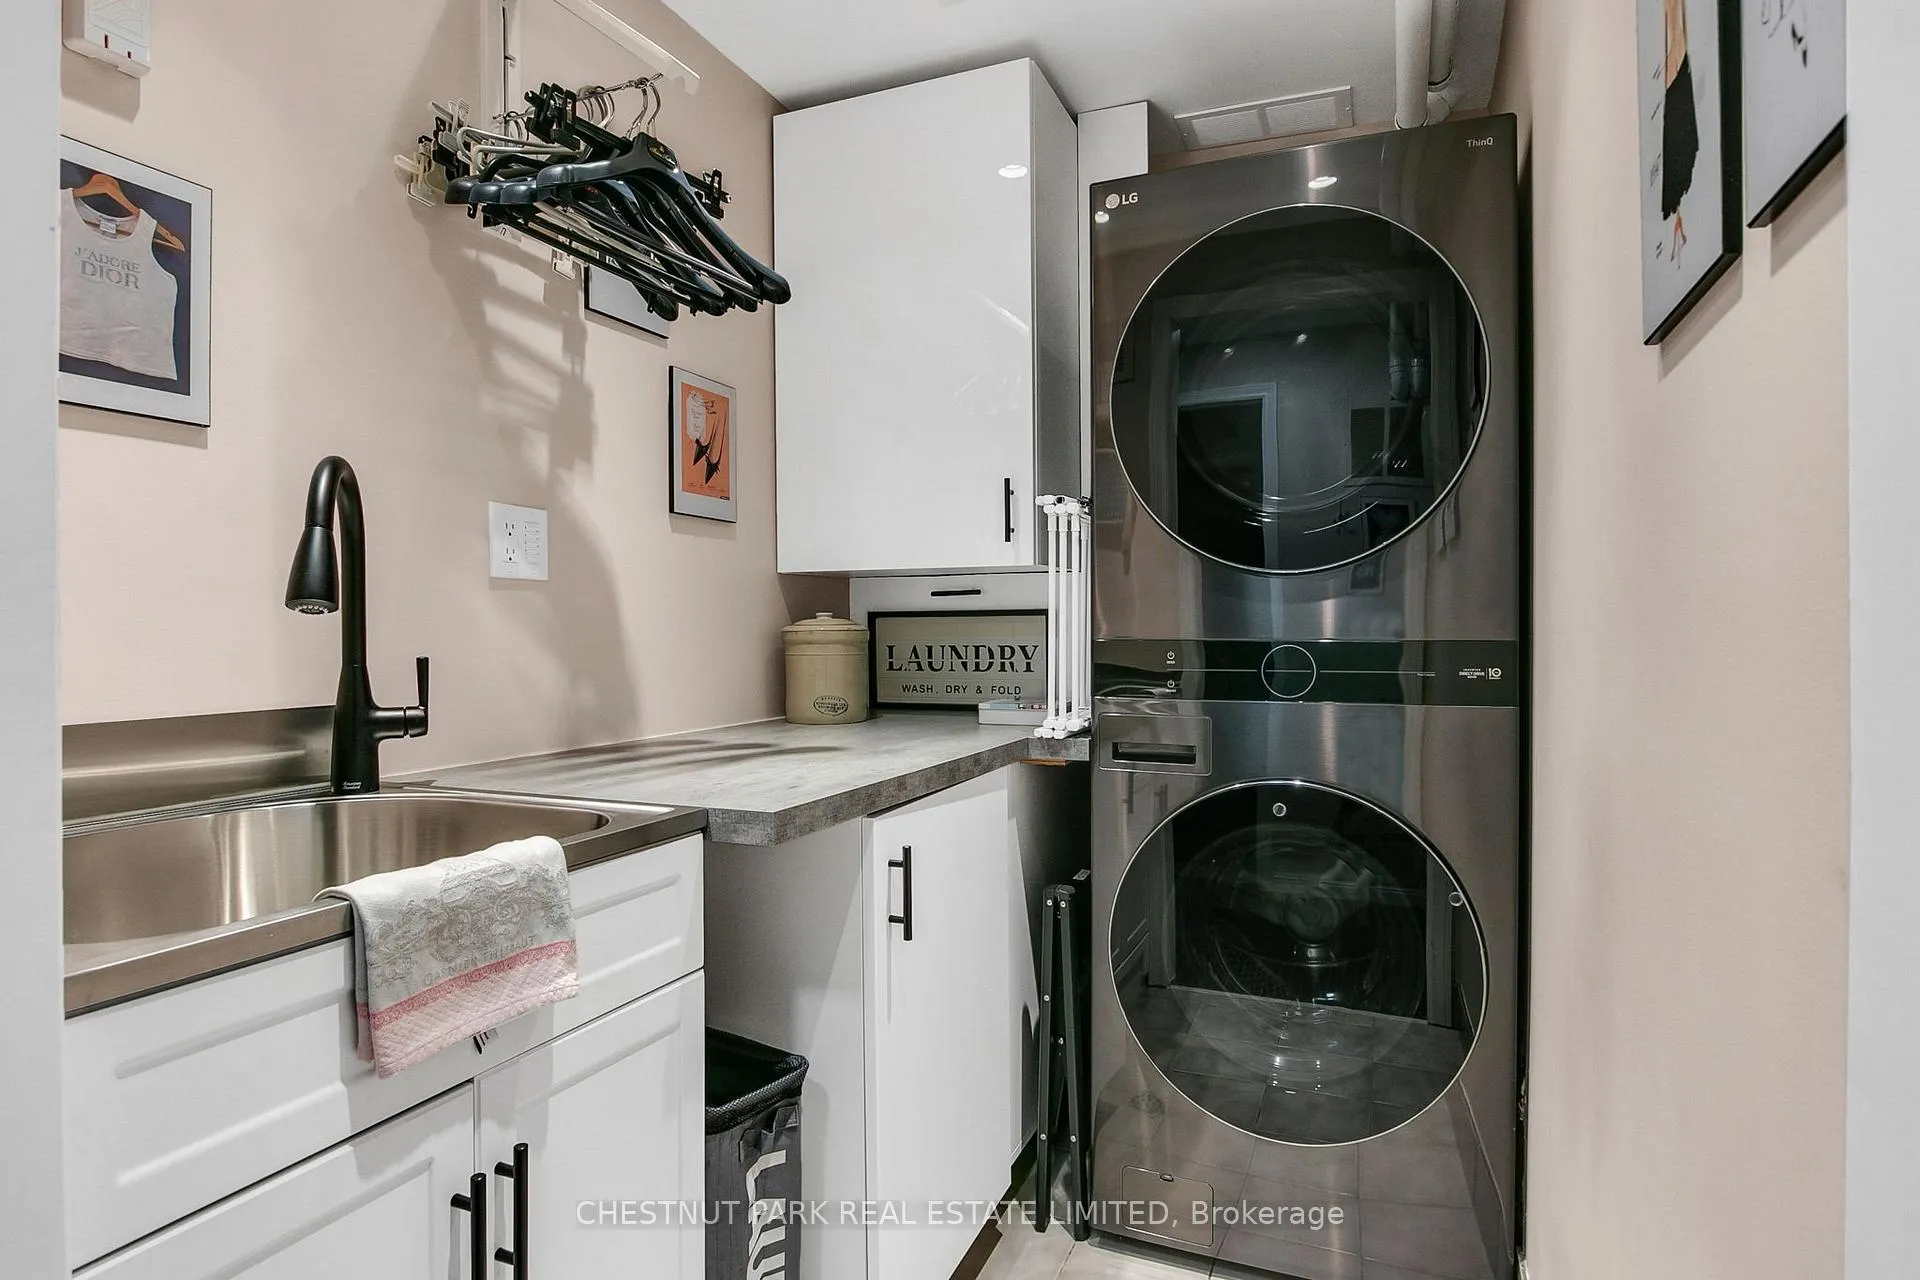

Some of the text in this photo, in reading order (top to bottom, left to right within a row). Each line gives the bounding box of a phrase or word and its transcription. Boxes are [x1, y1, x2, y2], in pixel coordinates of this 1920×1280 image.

[1465, 136, 1493, 147] ThinQ
[1122, 192, 1138, 205] LG
[74, 247, 142, 273] J'ADORE
[80, 260, 141, 290] DIOR
[885, 644, 1040, 673] LAUNDRY
[945, 685, 968, 694] DRY
[975, 685, 983, 695] &
[991, 685, 1022, 695] FOLD
